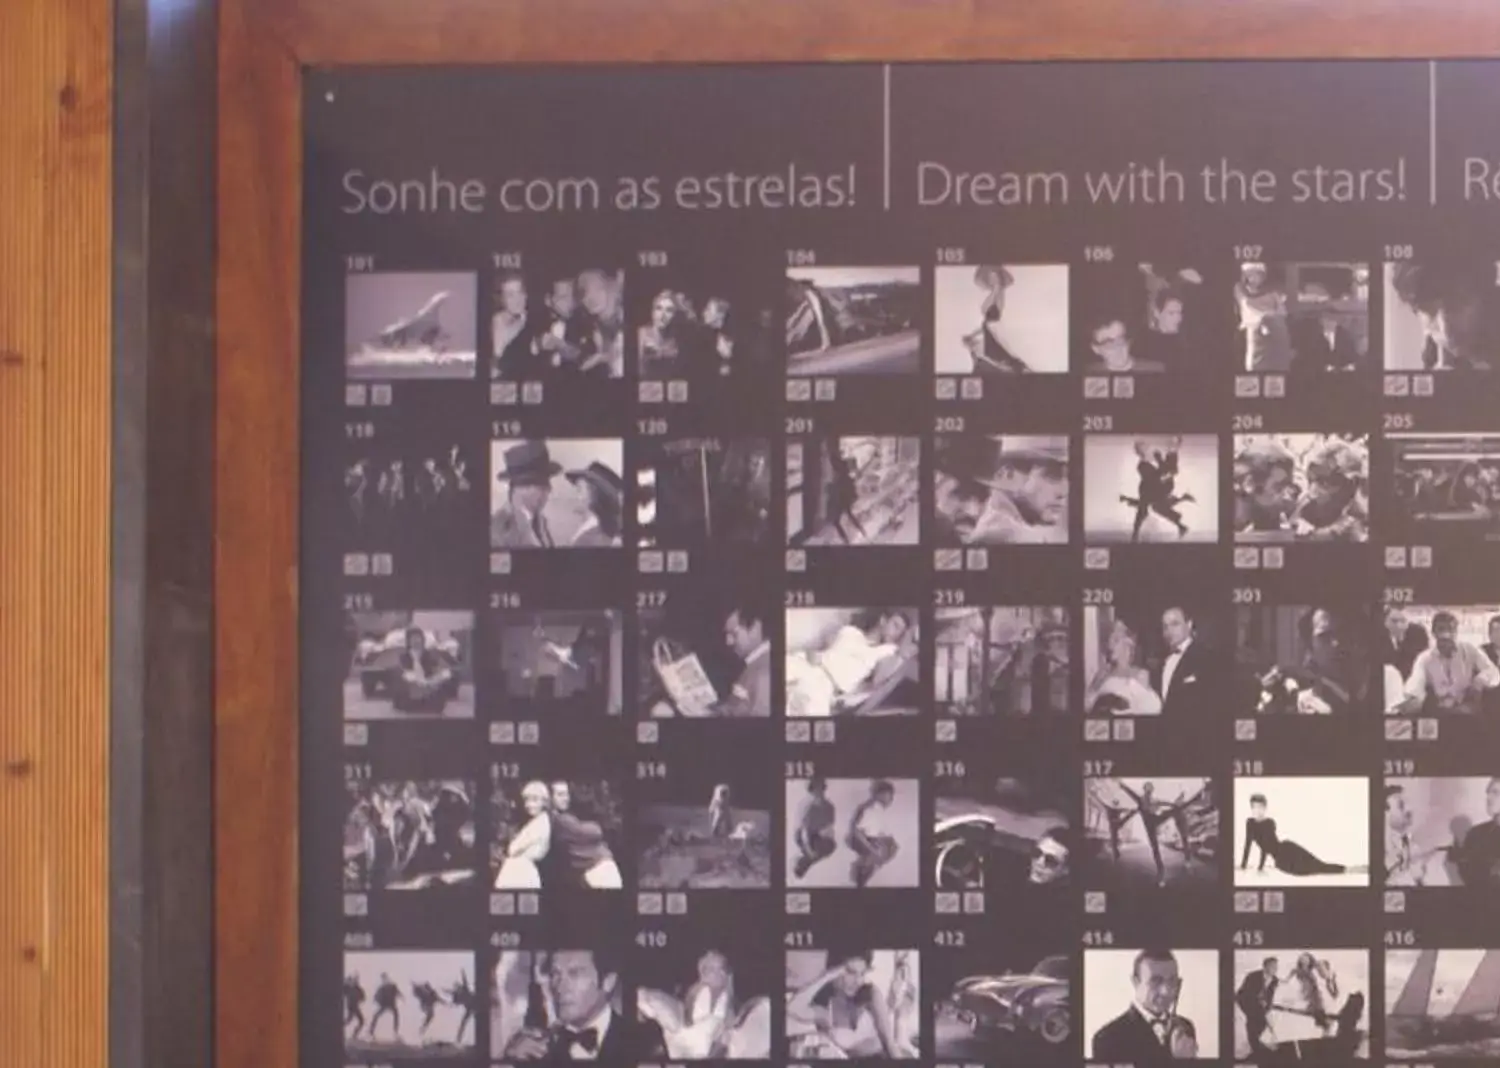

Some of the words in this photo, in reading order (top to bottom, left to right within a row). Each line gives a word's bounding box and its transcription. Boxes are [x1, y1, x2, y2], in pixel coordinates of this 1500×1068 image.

[342, 168, 485, 213] Sonhe
[500, 177, 599, 212] com
[614, 176, 660, 210] as
[675, 163, 856, 209] estrelas!
[917, 161, 1068, 204] Dream
[1085, 158, 1184, 203] with
[1201, 158, 1276, 203] the
[1291, 158, 1407, 203] stars!
[786, 250, 815, 264] 104
[936, 248, 965, 262] 105
[1084, 246, 1114, 262] 106
[1233, 246, 1263, 259] 107
[1384, 245, 1413, 258] 108
[492, 421, 521, 435] 119
[785, 418, 813, 433] 201
[1083, 415, 1113, 430] 203
[1232, 415, 1263, 430] 204
[1383, 414, 1413, 428] 205
[490, 593, 520, 608] 216
[636, 592, 667, 606] 217
[785, 591, 815, 605] 218
[934, 590, 965, 604] 219
[1083, 589, 1113, 603] 220
[1233, 588, 1261, 603] 301
[1383, 588, 1413, 602] 302
[344, 763, 372, 779] 311
[636, 763, 667, 778] 314
[785, 762, 815, 777] 315
[934, 761, 965, 777] 316
[1083, 760, 1113, 776] 317
[1233, 760, 1263, 776] 318
[1384, 760, 1414, 775] 319
[490, 932, 520, 946] 409
[636, 932, 667, 947] 410
[784, 932, 813, 946] 411
[934, 932, 965, 946] 412
[1082, 931, 1113, 945] 414
[1233, 931, 1264, 945] 415
[1384, 931, 1415, 945] 416
